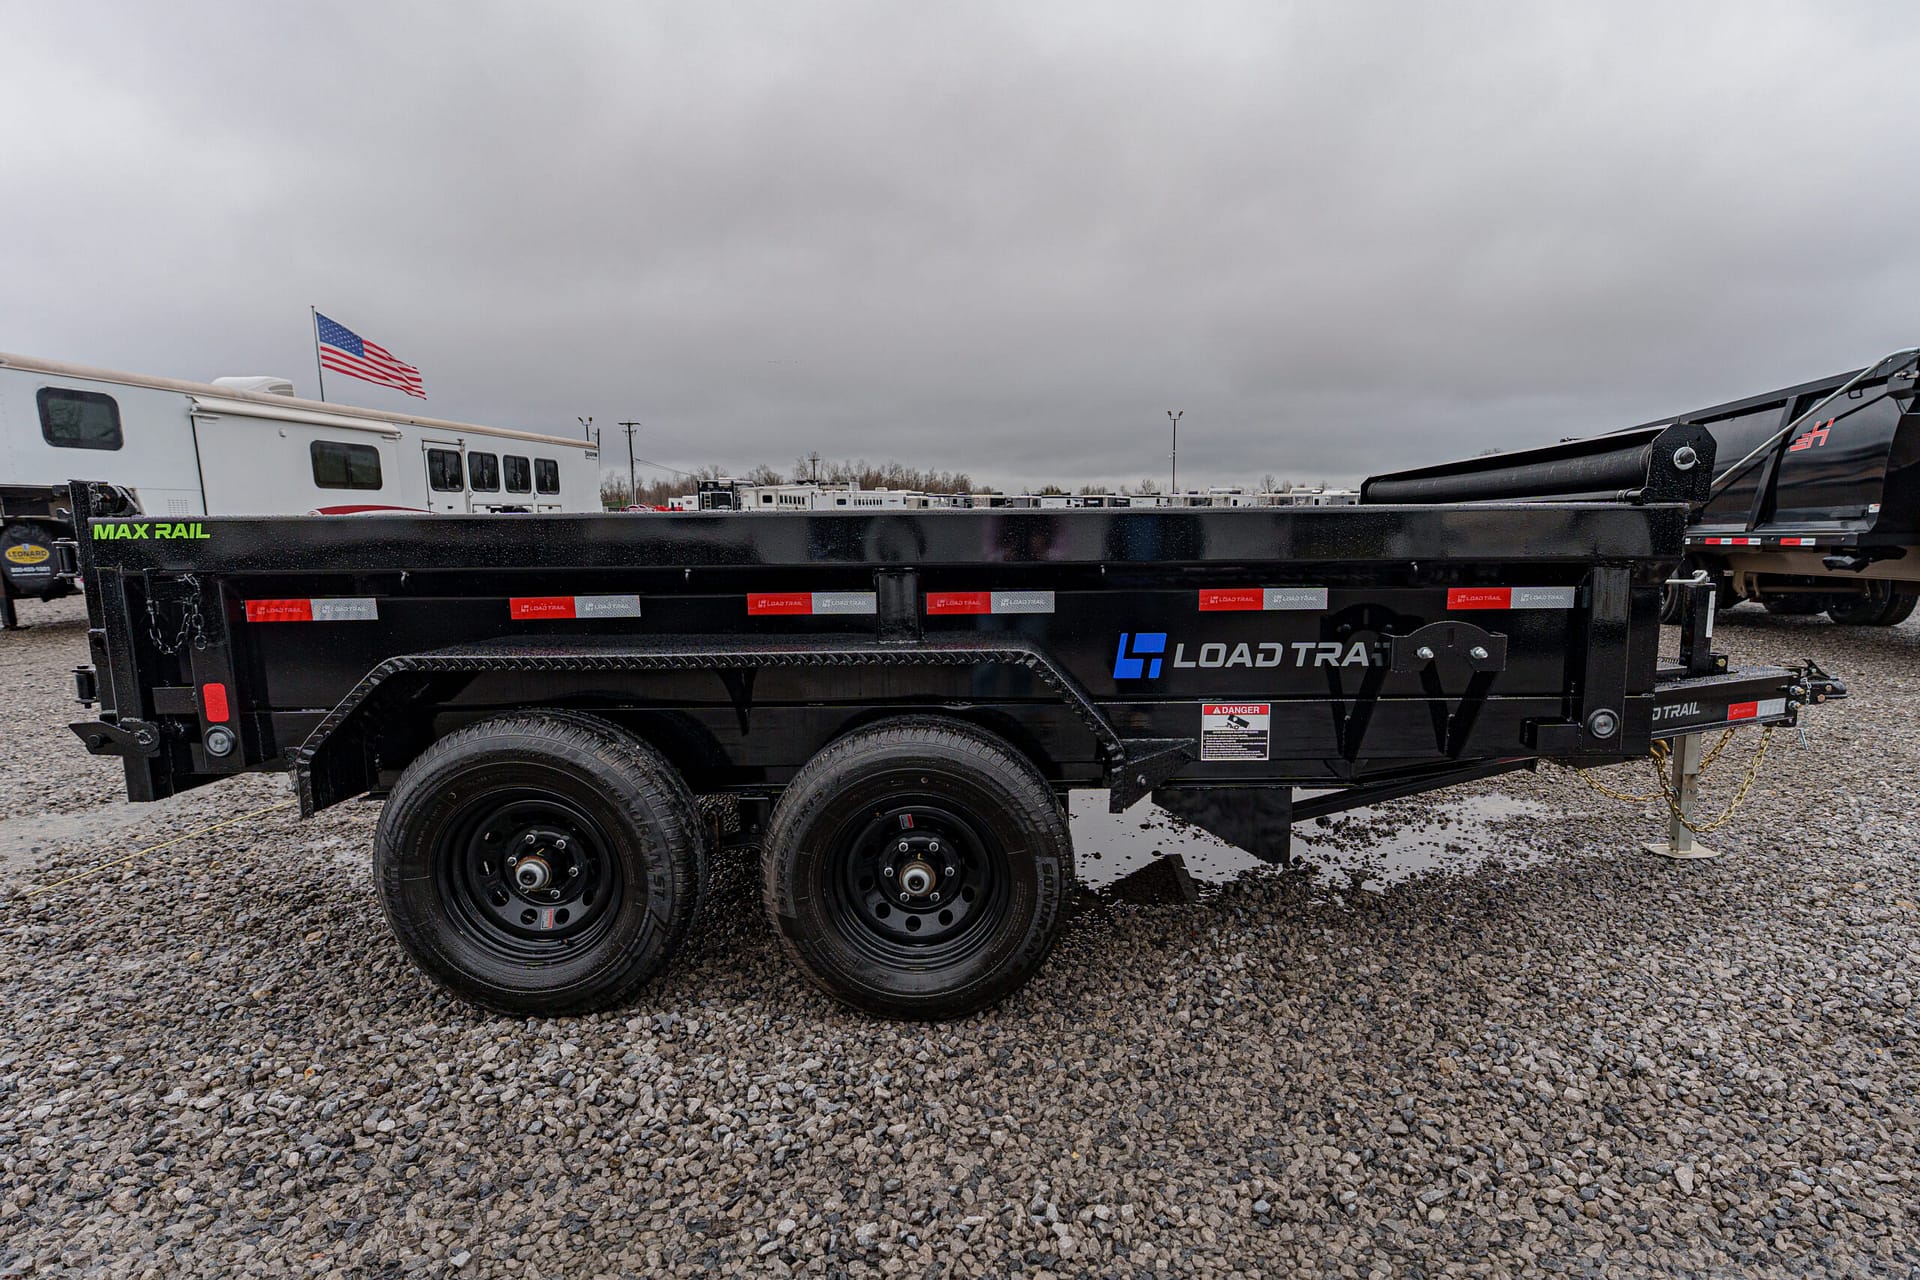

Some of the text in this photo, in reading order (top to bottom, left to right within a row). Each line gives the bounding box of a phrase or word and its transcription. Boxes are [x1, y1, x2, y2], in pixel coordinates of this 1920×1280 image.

[93, 522, 211, 540] MAX RAIL
[1173, 641, 1370, 668] LOAD TRA
[1221, 706, 1260, 714] DANGER
[1663, 701, 1701, 719] TRAIL
